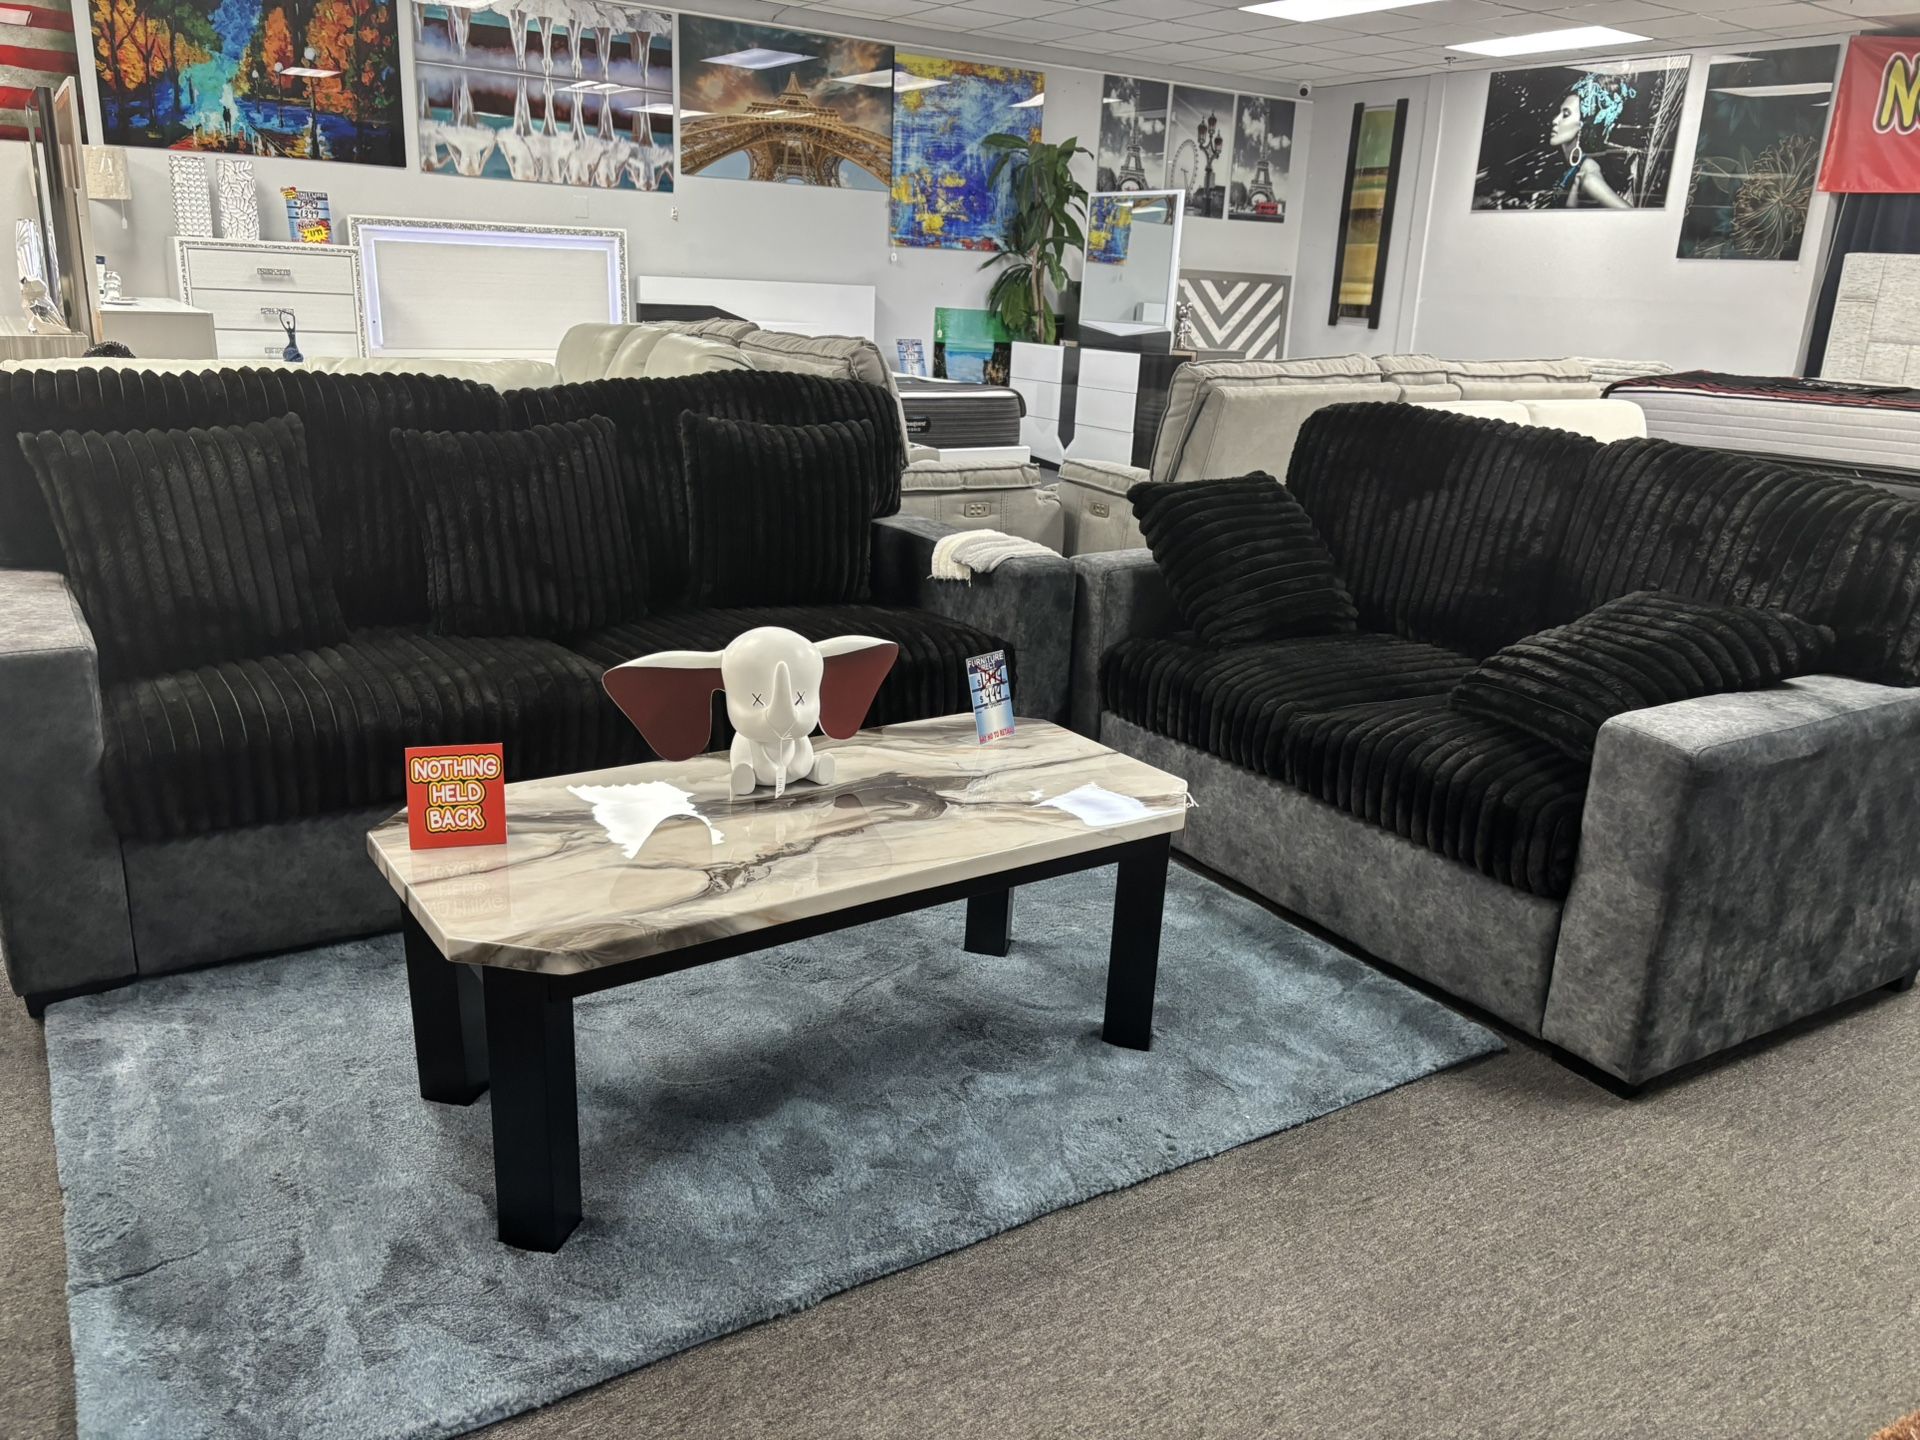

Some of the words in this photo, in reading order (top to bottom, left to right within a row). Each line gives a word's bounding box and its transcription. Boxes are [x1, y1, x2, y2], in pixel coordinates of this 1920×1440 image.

[967, 653, 1004, 667] FURNITURE
[412, 755, 500, 781] NOTHING
[431, 781, 484, 805] HELD
[428, 806, 483, 830] BACK
